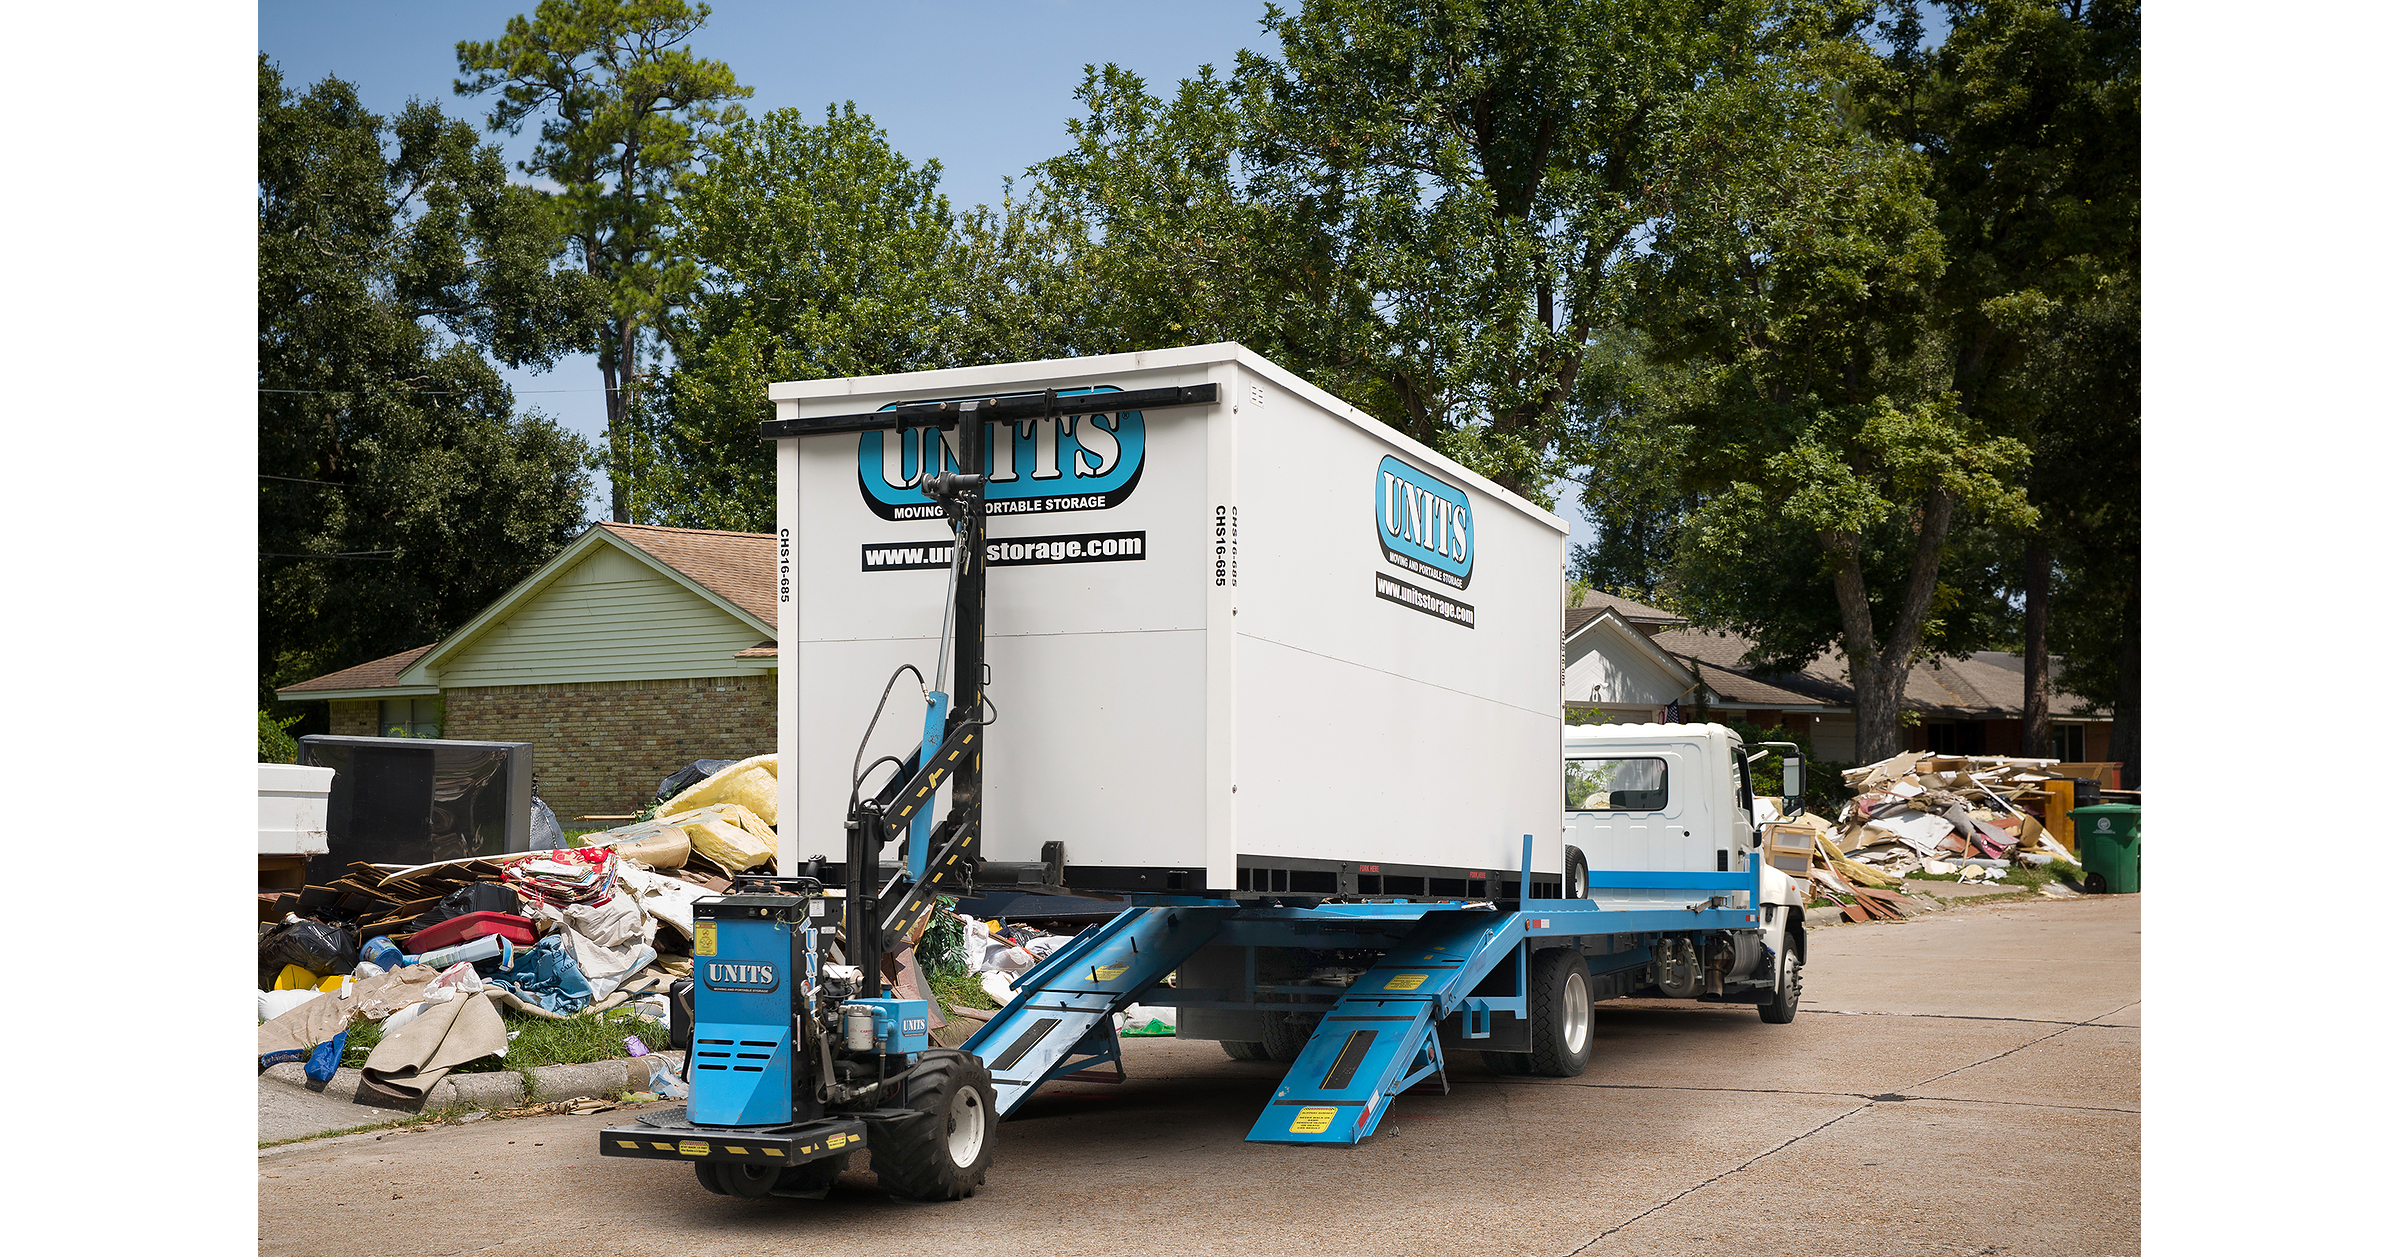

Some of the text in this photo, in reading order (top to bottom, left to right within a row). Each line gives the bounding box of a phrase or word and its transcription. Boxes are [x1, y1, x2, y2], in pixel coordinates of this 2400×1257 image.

[894, 505, 944, 519] MOVING
[985, 500, 1042, 514] ORTABLE
[1045, 496, 1106, 510] STORAGE
[1383, 470, 1467, 564] UNITS
[865, 536, 1142, 567] www.unstorage.com
[1215, 505, 1226, 587] CHS16-685
[780, 528, 790, 603] CHS16-685
[1389, 551, 1463, 589] MOVING AND PORTABLE STORAGE
[1377, 577, 1474, 625] www.unitsstorage.com
[1360, 864, 1380, 873] FORK HERE
[709, 963, 773, 984] UNITS
[903, 1019, 925, 1031] UNITS
